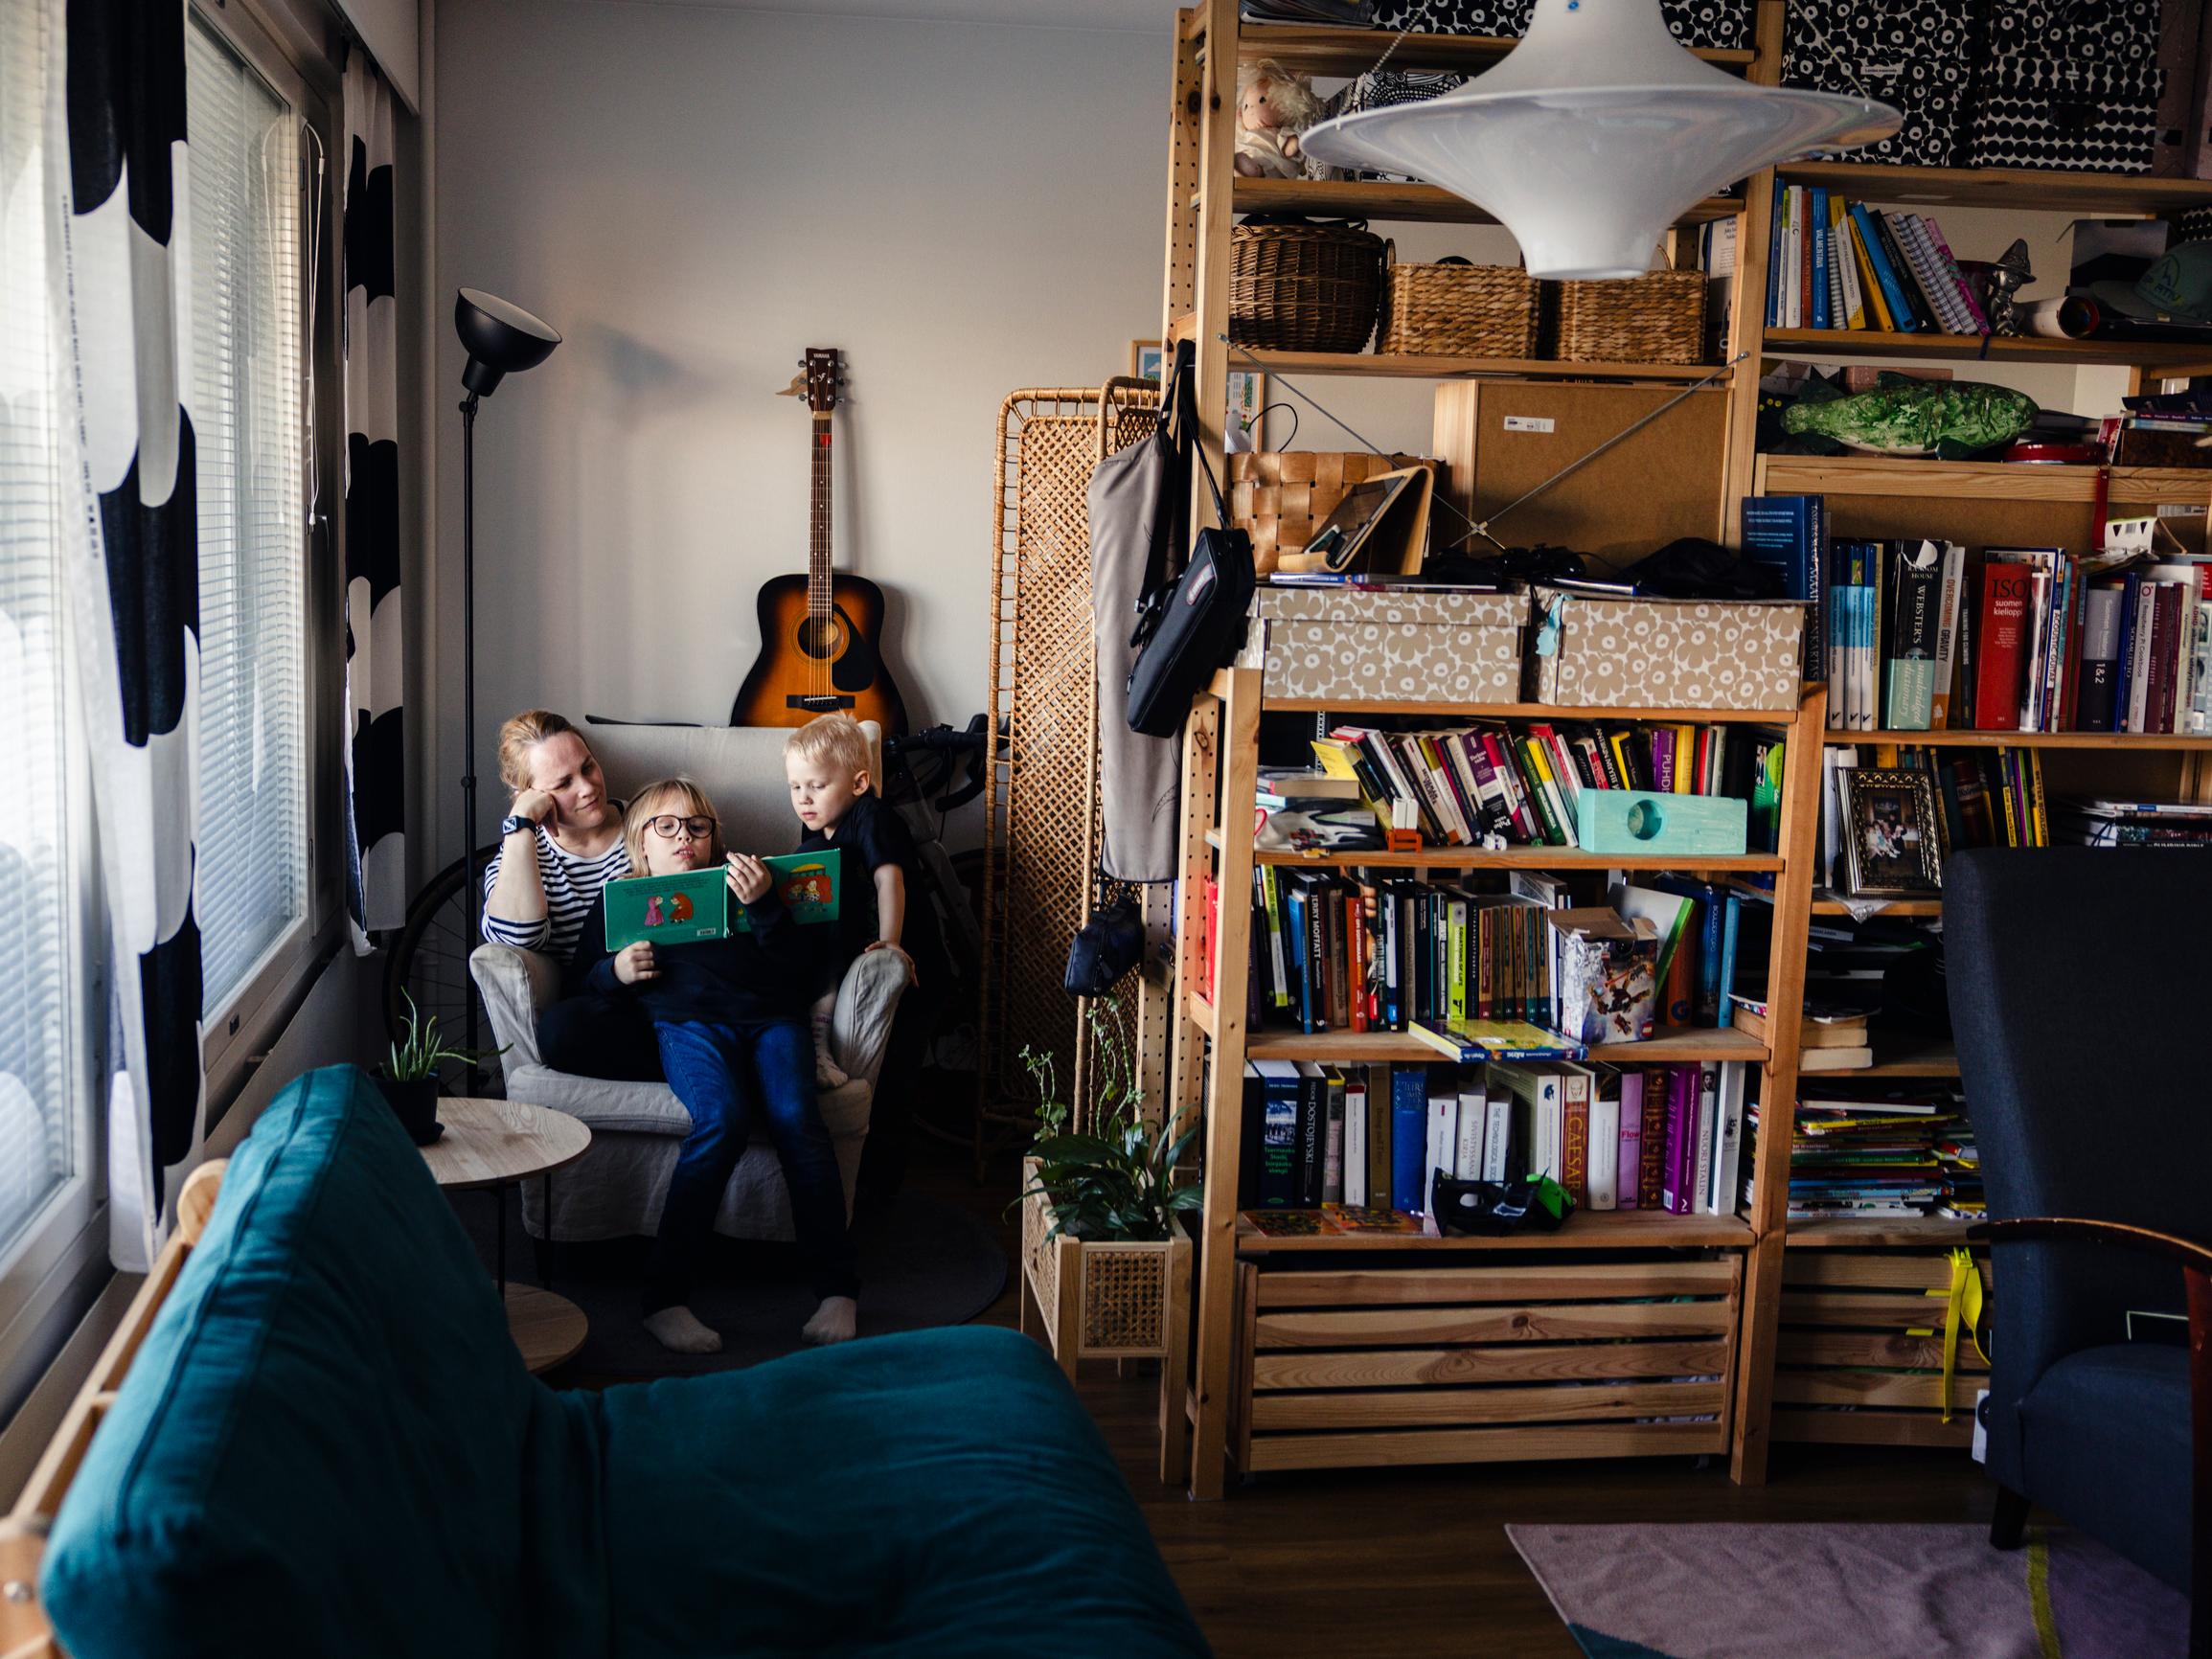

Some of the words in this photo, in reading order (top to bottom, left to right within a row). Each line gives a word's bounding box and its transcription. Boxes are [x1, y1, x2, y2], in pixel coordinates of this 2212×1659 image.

[1815, 228, 1824, 268] VALMENTAVA
[1942, 579, 1956, 628] OVERCOMING
[1992, 579, 2028, 598] ISO
[1913, 584, 1926, 644] WEBSTER'S
[1993, 607, 2023, 618] kielioppi
[2138, 604, 2149, 637] Raspberry
[1938, 629, 1951, 662] GRAVITY
[2050, 612, 2060, 654] ACOUSTIC
[1900, 663, 1914, 717] dictionary
[2095, 663, 2106, 684] 1&2
[1911, 664, 1927, 725] unabridged
[1310, 894, 1319, 920] JERRY
[1312, 920, 1321, 958] MOFFATT
[1305, 1101, 1317, 1164] DOSTOJEVSKI
[1469, 1120, 1478, 1179] SIVISTYSSANA-
[1491, 1120, 1500, 1164] TECHNOLOGICAL
[1621, 1130, 1639, 1138] Flow
[1701, 1130, 1709, 1161] NUORI
[1567, 1116, 1583, 1190] CAESAR
